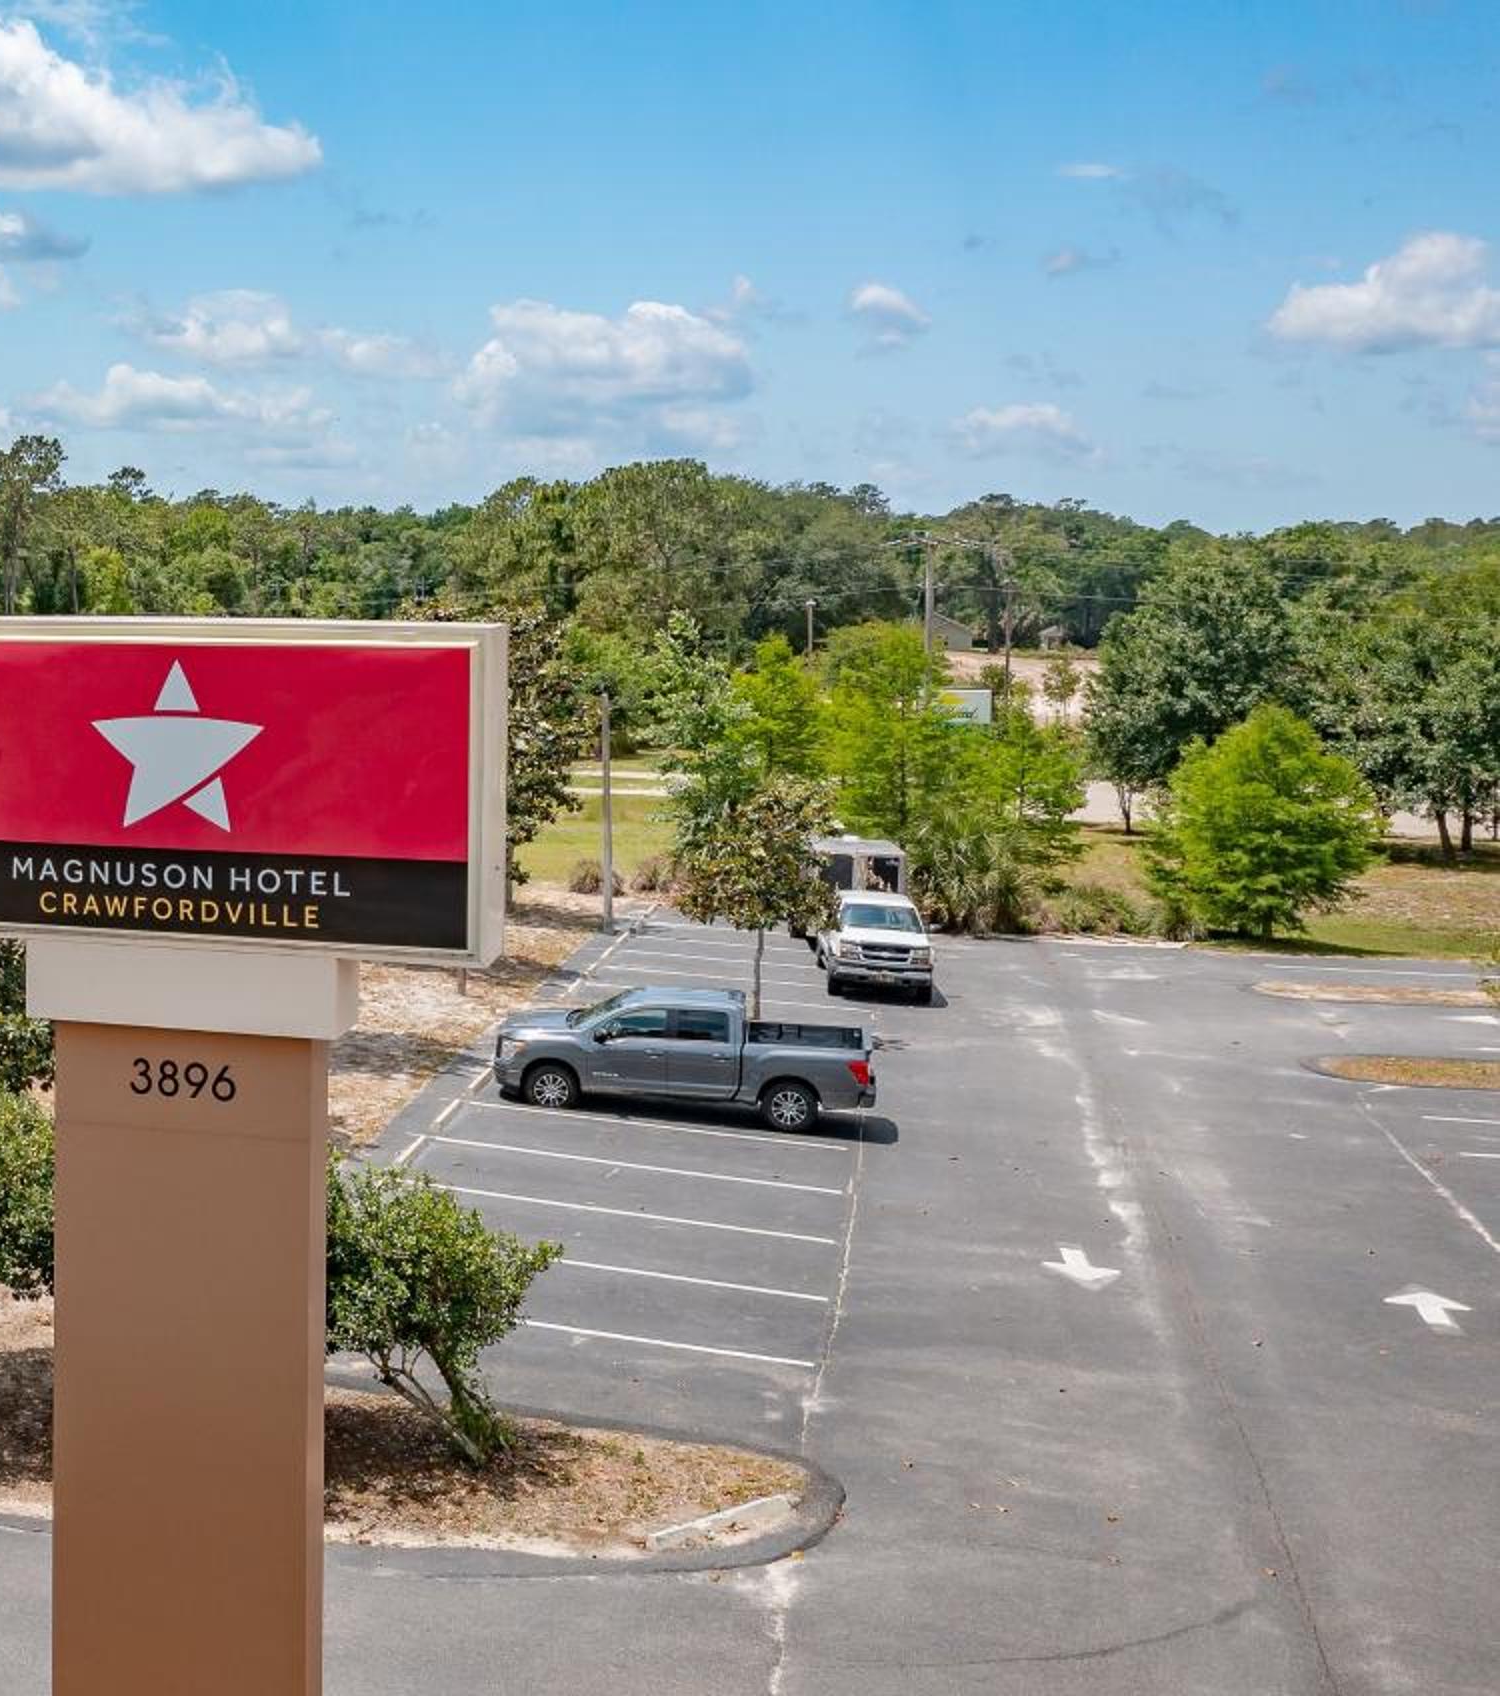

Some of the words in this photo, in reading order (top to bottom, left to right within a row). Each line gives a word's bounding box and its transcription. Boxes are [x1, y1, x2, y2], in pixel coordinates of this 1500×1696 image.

[12, 857, 213, 890] MAGNUSON
[230, 867, 351, 897] HOTEL
[39, 891, 319, 929] CRAWFORDVILLE
[129, 1057, 237, 1103] 3896
